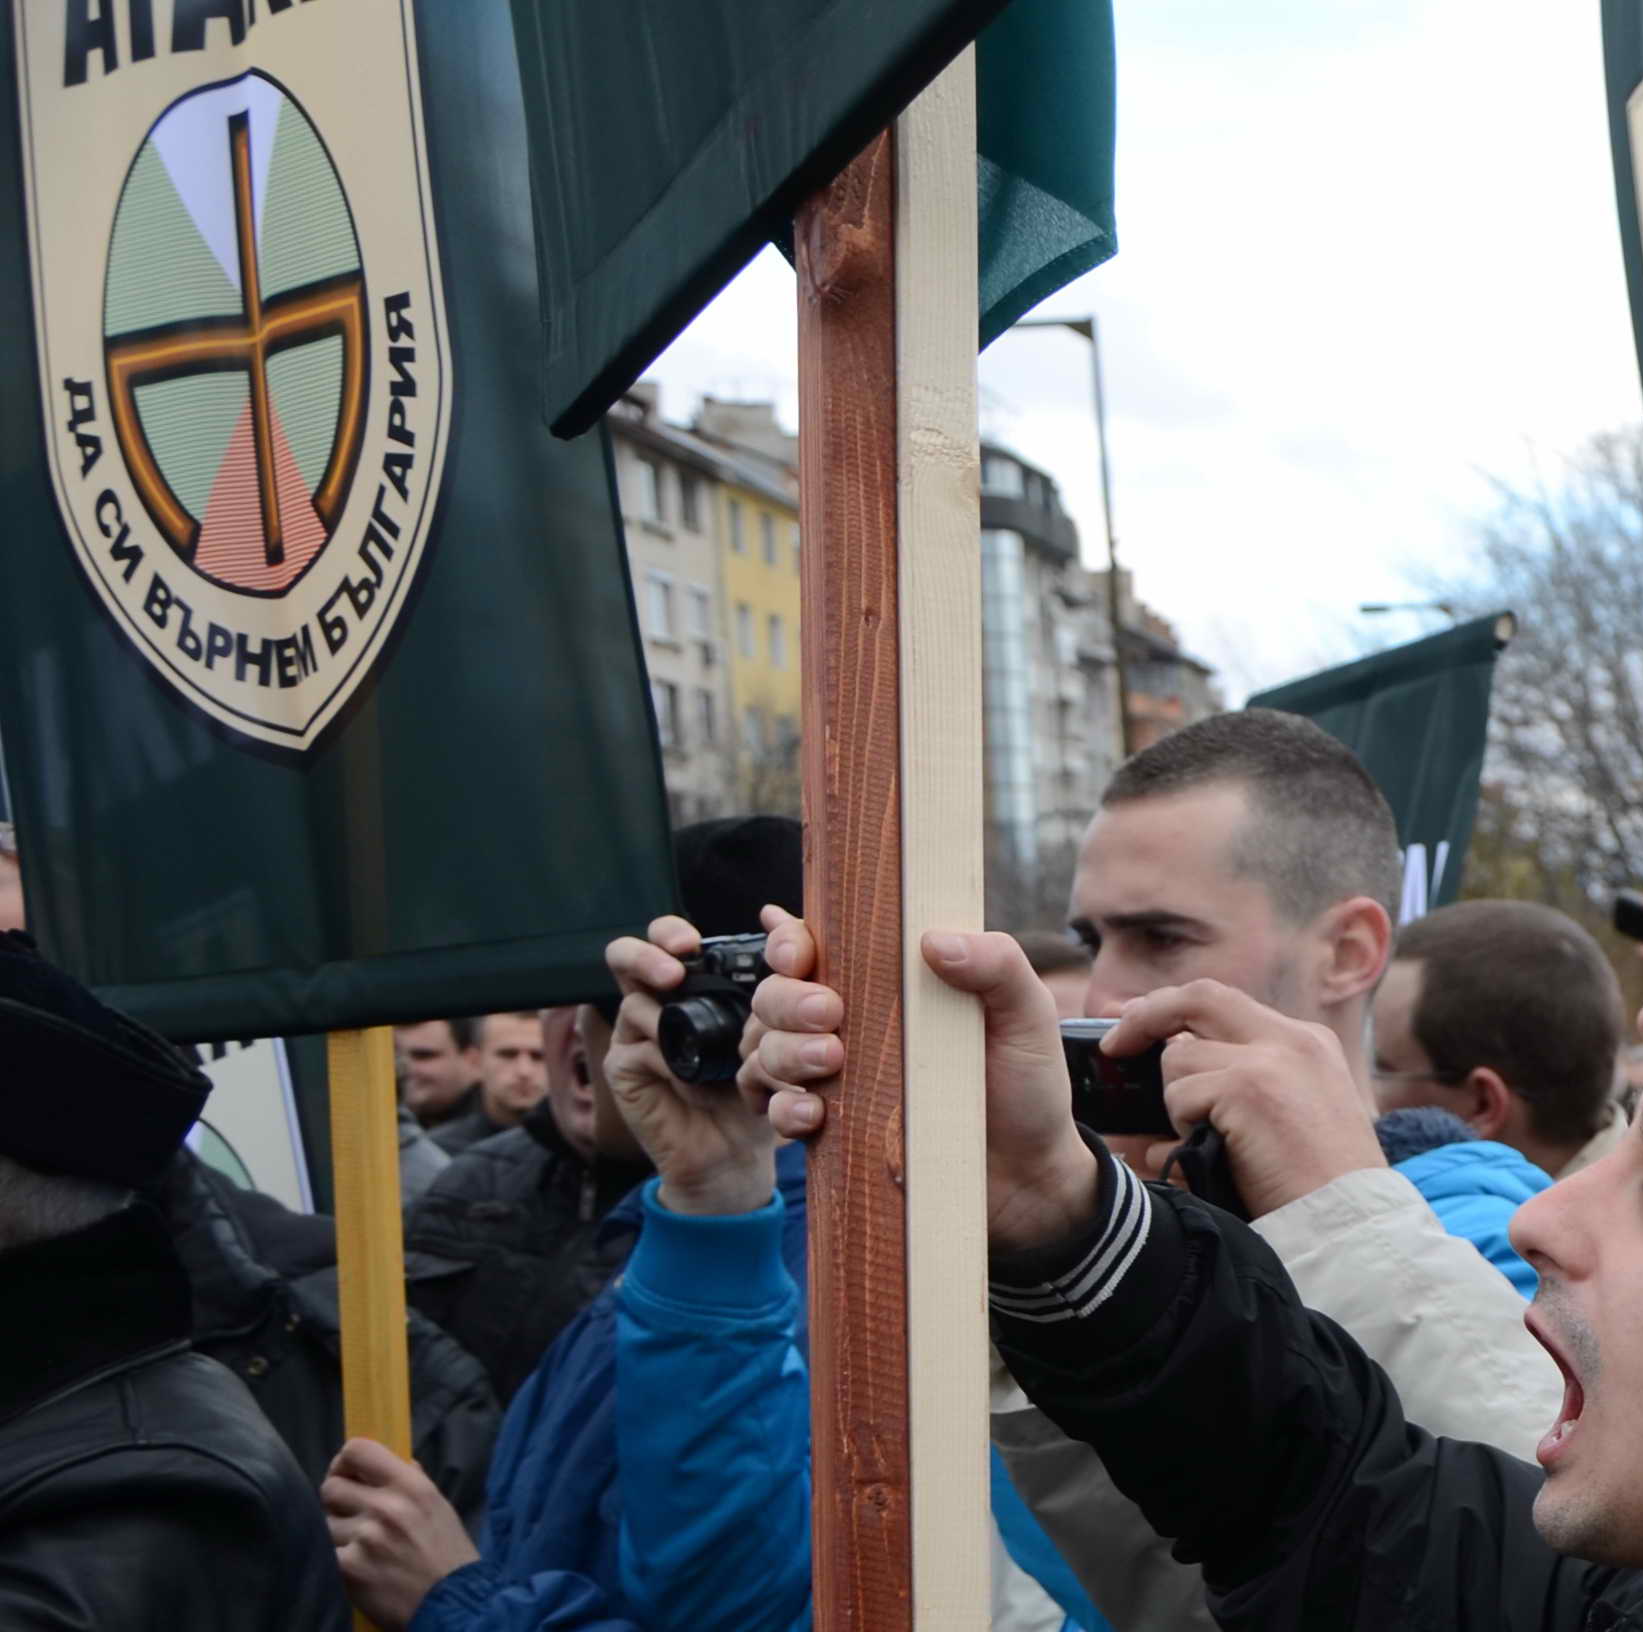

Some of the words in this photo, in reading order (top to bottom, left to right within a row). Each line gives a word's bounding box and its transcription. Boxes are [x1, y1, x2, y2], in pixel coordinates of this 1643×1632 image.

[62, 376, 103, 481] ДА
[94, 488, 145, 585] СИ
[315, 290, 418, 657] БЪЛГАРИЯ
